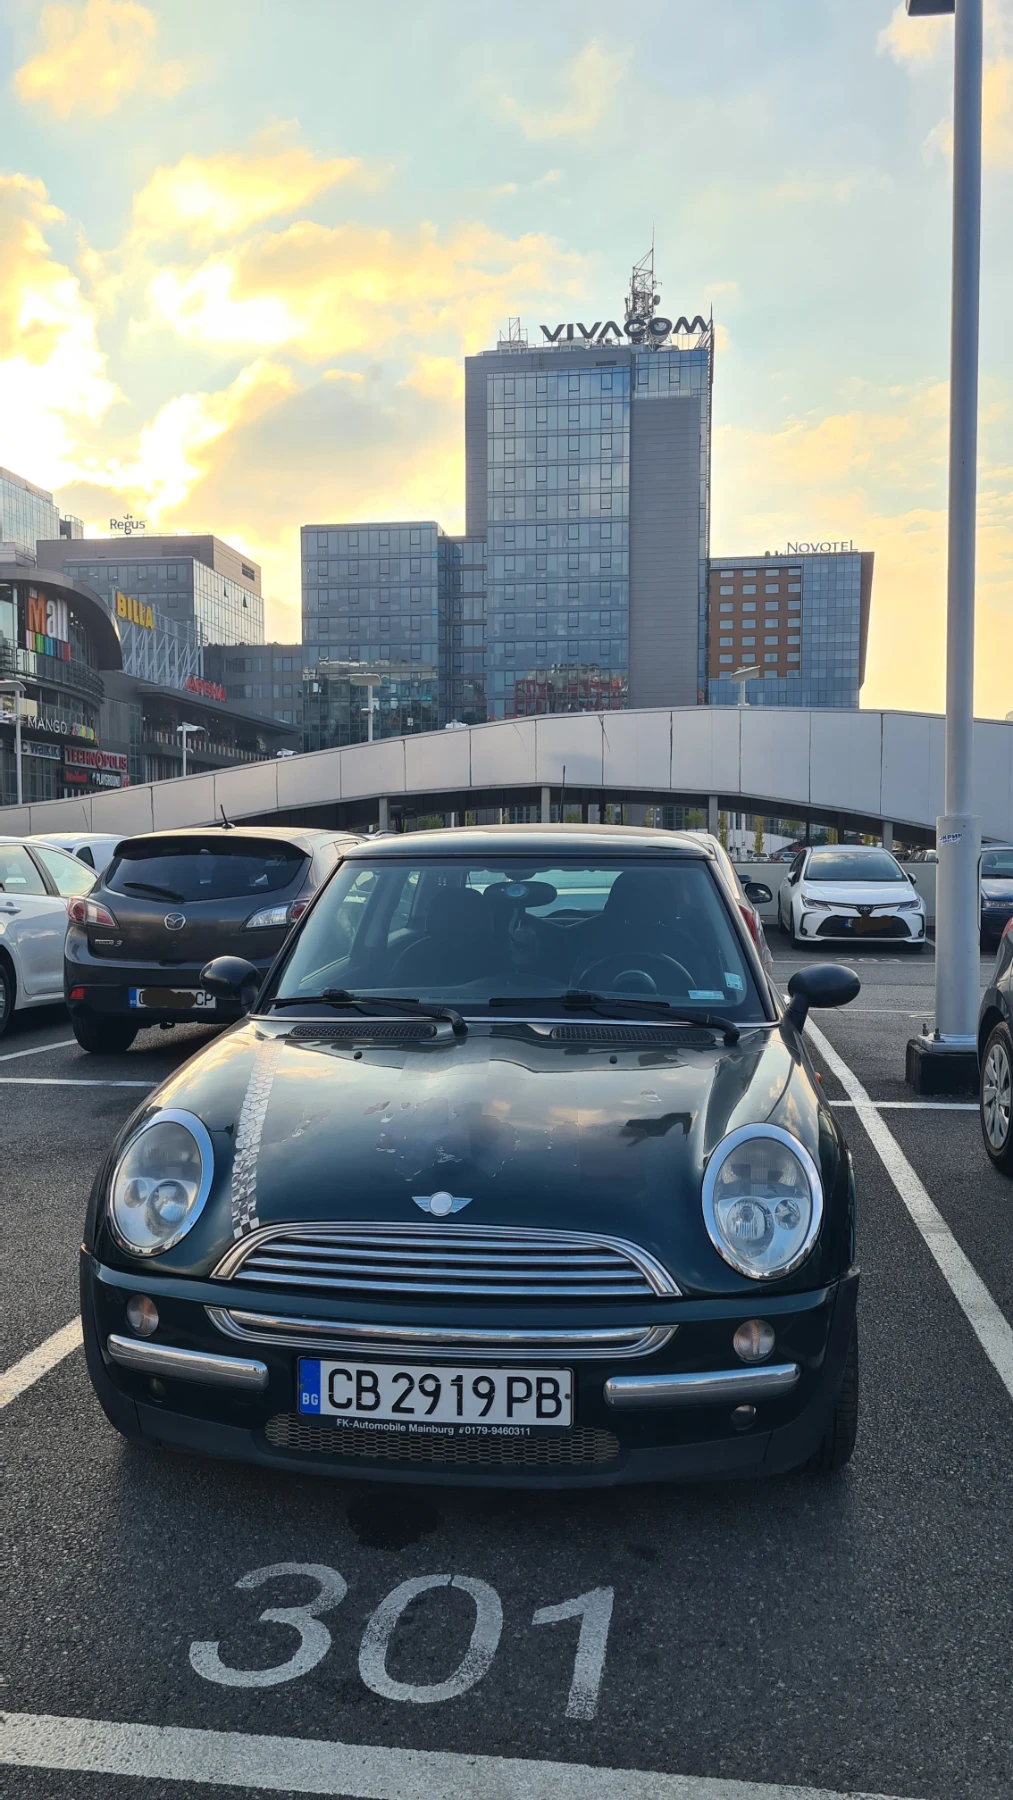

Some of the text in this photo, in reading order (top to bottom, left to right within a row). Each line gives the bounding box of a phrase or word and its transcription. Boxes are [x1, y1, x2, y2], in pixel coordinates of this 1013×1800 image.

[540, 315, 711, 342] VIVACOM
[110, 518, 146, 534] Regus
[787, 540, 858, 553] NOVOTEL
[27, 592, 69, 643] Mall
[115, 591, 153, 630] BILLA
[28, 715, 67, 734] MANGO
[66, 748, 127, 771] TECHNOPOLIS
[302, 1392, 318, 1405] BG
[391, 1372, 496, 1417] 2919
[336, 1418, 406, 1432] FK-Automobile
[408, 1424, 454, 1436] Mainburg
[189, 1562, 615, 1720] 301
